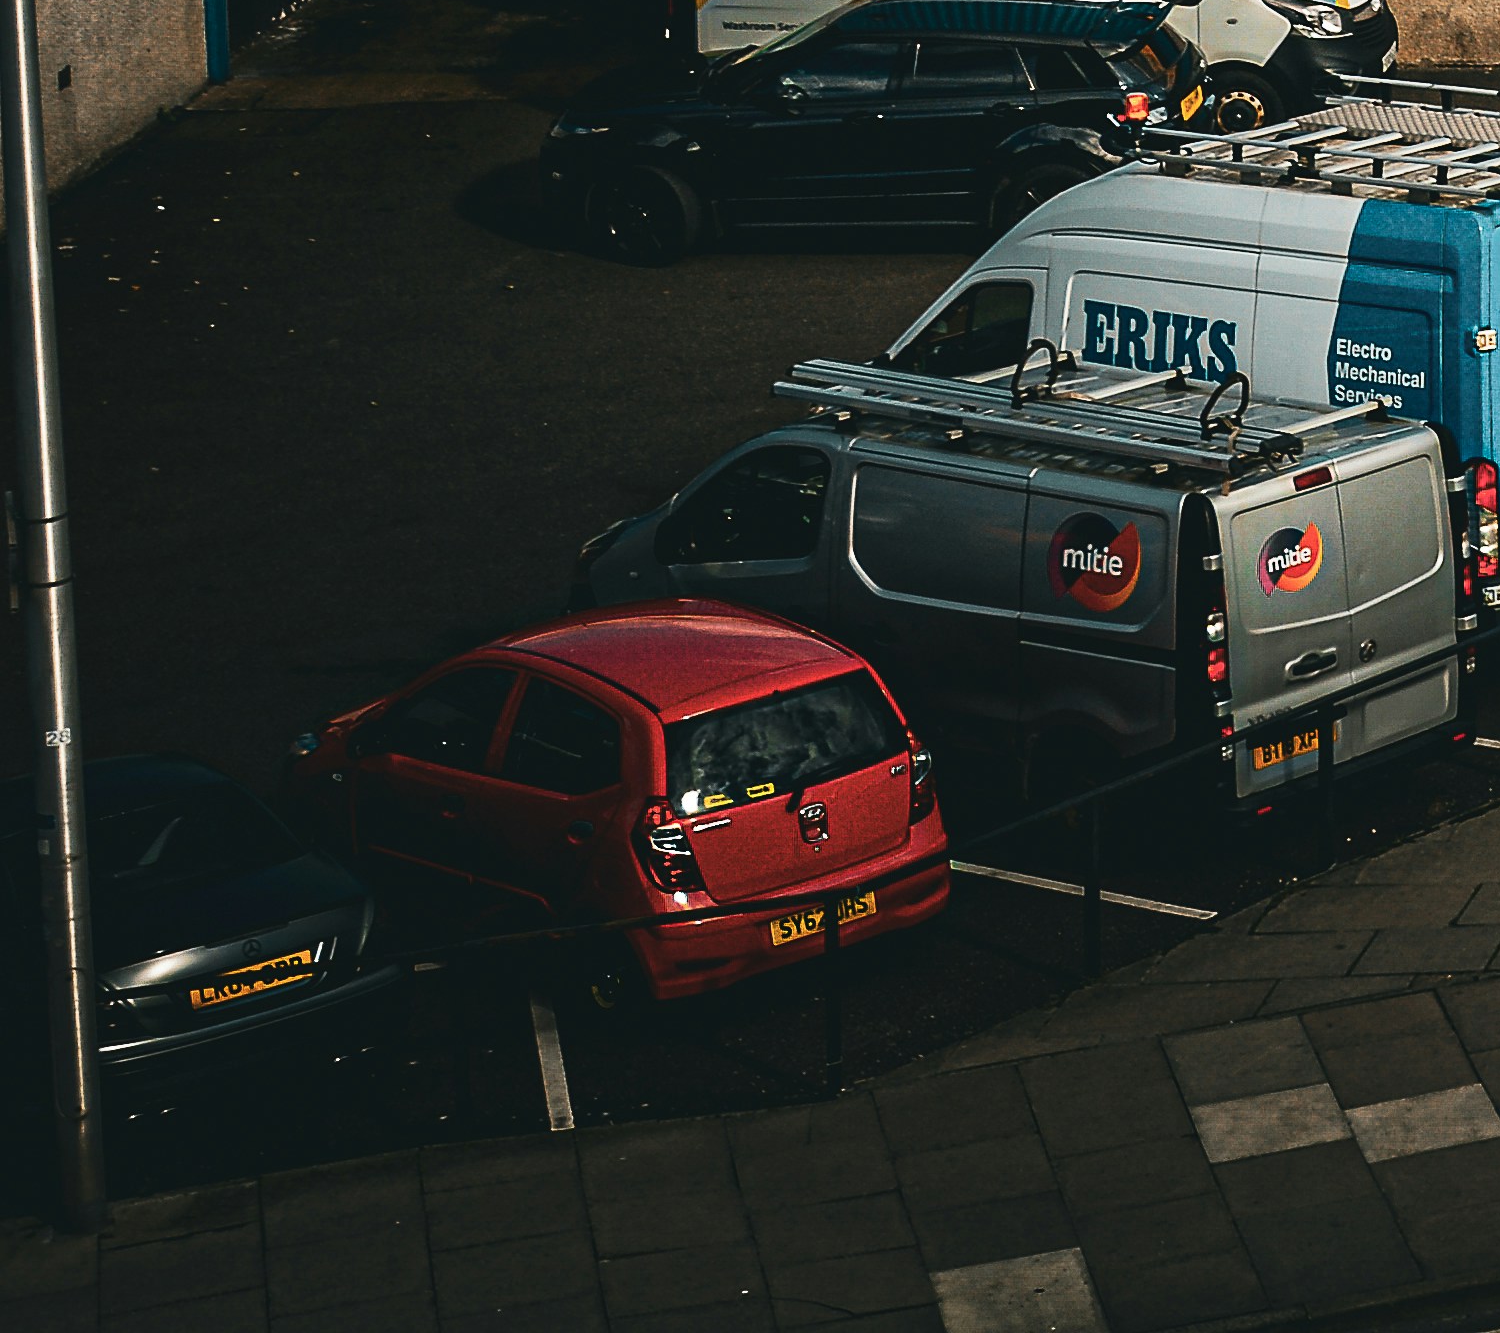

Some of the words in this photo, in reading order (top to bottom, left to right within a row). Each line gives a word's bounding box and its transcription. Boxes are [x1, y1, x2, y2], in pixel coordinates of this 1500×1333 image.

[1082, 299, 1238, 383] ERIKS
[1336, 338, 1392, 362] Electro
[1335, 361, 1426, 390] Mechanical
[1062, 544, 1123, 576] mitie
[1267, 544, 1312, 574] mitie
[47, 730, 70, 745] 28
